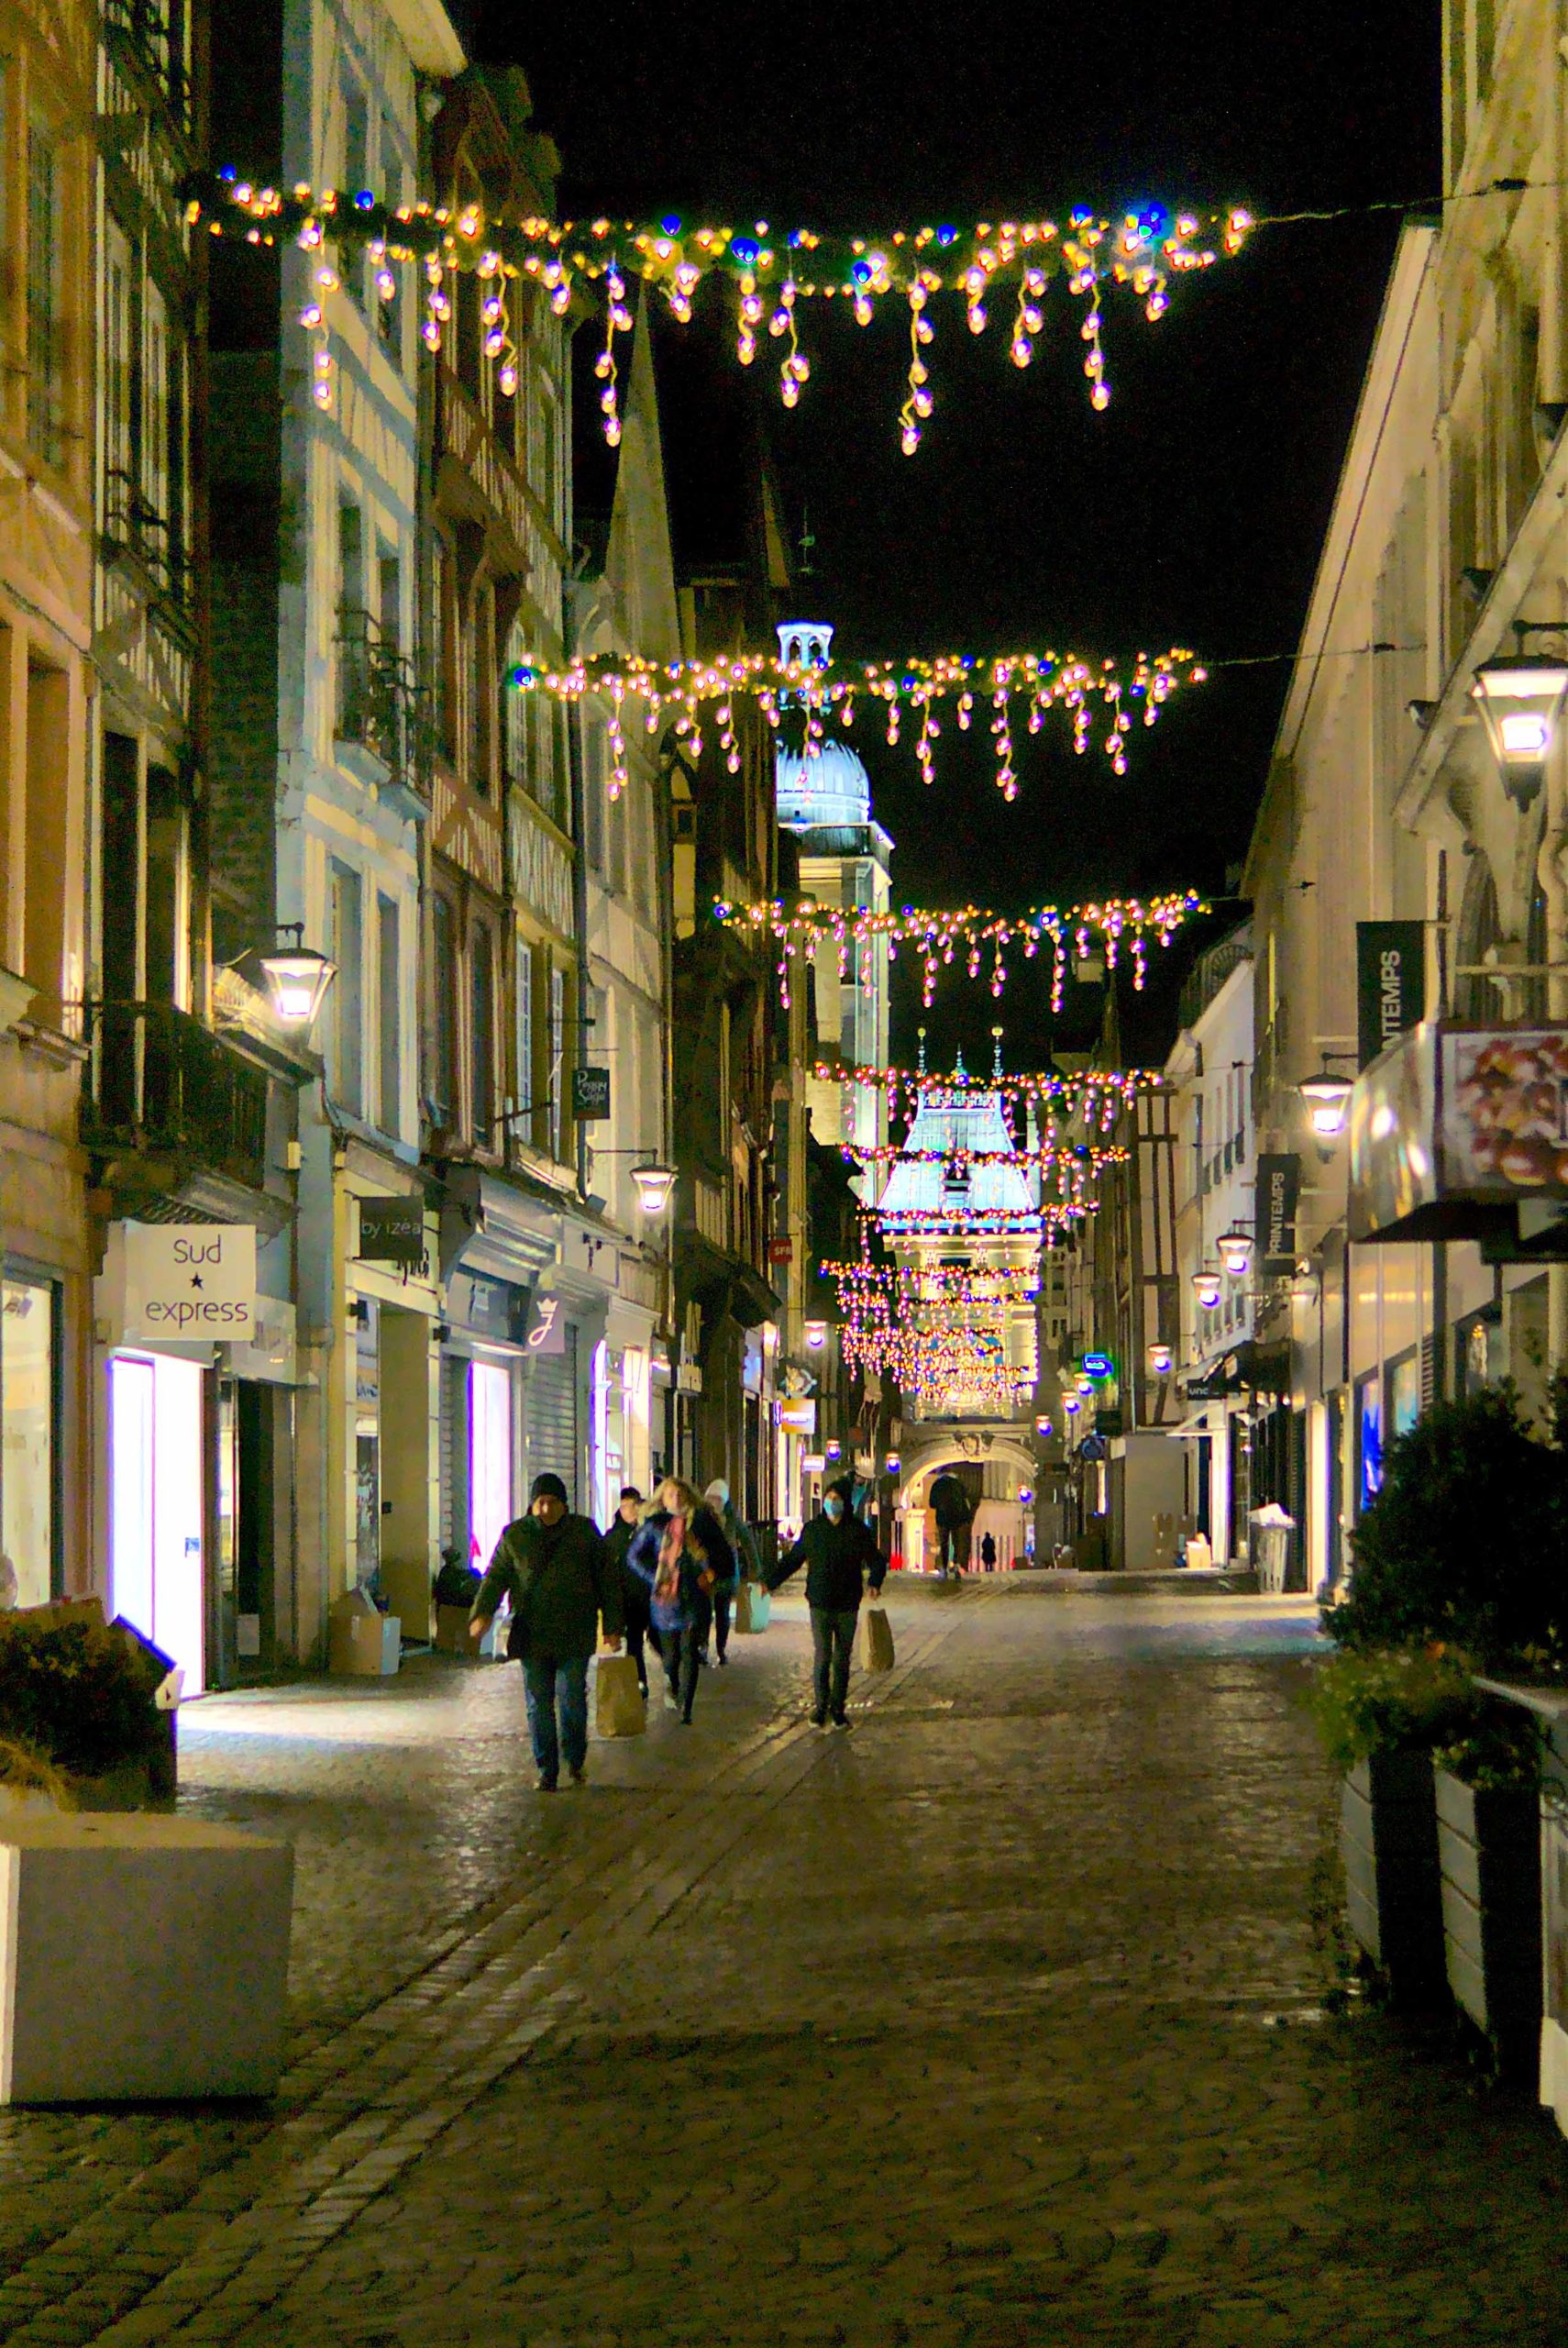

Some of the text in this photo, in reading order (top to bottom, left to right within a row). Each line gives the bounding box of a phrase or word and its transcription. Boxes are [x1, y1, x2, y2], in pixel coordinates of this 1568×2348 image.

[1380, 950, 1402, 1052] NTEMPS
[361, 1218, 381, 1239] by
[1269, 1172, 1286, 1255] PRINTEMPS
[172, 1234, 222, 1264] Sud
[145, 1301, 248, 1330] express
